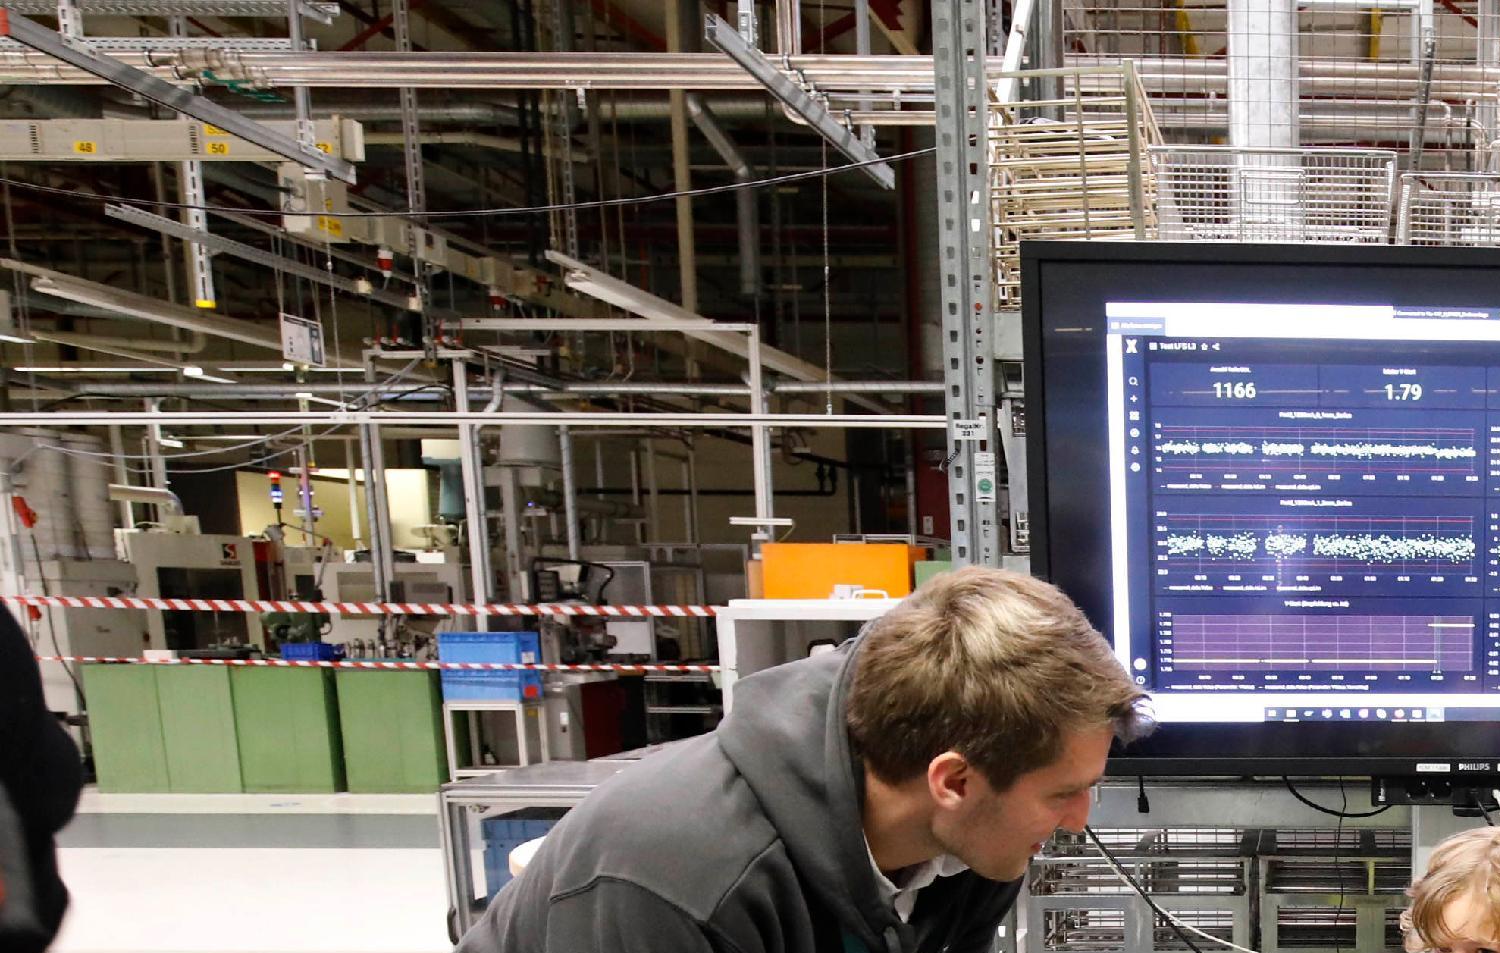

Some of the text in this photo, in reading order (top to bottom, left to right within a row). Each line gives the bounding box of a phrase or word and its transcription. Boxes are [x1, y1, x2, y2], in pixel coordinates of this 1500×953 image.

[211, 143, 224, 153] 50
[1213, 382, 1256, 398] 1166
[1385, 383, 1422, 400] 1.79
